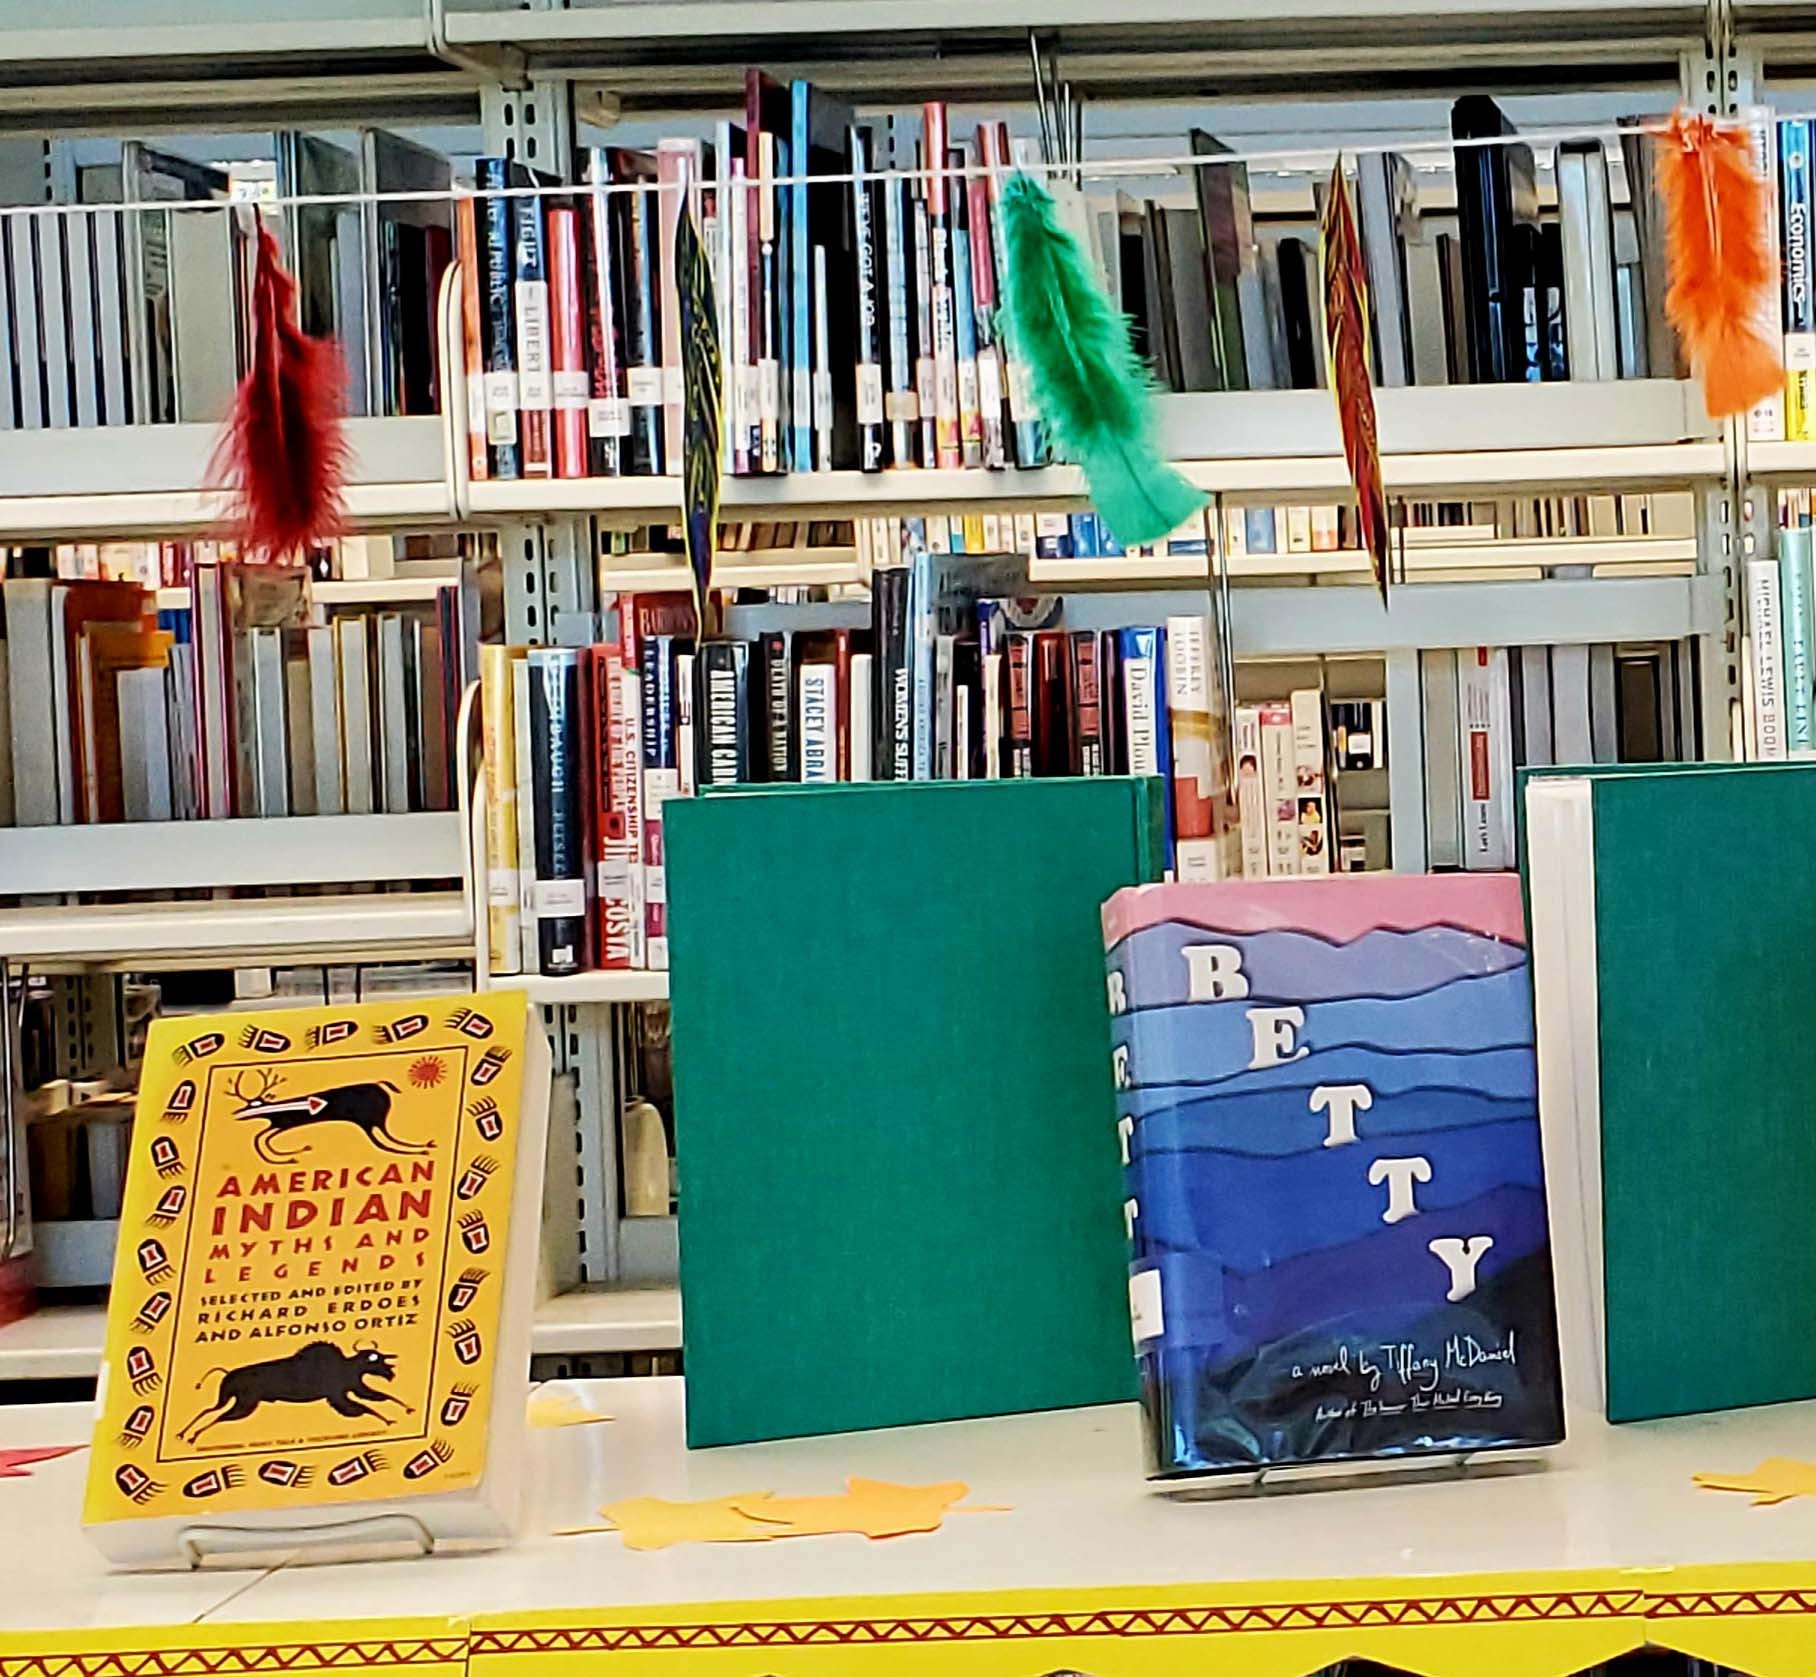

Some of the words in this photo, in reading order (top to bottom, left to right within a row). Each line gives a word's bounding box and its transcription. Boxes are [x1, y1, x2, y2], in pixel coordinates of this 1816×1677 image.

[1788, 203, 1807, 303] Economics
[522, 305, 543, 374] LIBERT
[1129, 666, 1149, 721] David
[1759, 655, 1776, 707] LEWIS
[709, 669, 737, 744] AMERICAN
[804, 678, 825, 733] STACEY
[771, 730, 788, 772] NATION
[1131, 729, 1151, 771] Plou
[1762, 713, 1777, 757] BOOM
[711, 749, 738, 784] CARN
[804, 738, 826, 779] ABRA
[894, 742, 910, 781] SUFF
[624, 751, 638, 838] CITIZENSHIP
[1106, 968, 1140, 1240] BETT
[216, 1159, 437, 1199] AMERICAN
[210, 1188, 432, 1237] INDIAN
[206, 1234, 335, 1261] MYTHS
[355, 1227, 432, 1249] AND
[203, 1251, 427, 1285] LEGENDS
[196, 1303, 310, 1326] RICHARD
[326, 1294, 422, 1316] ERDOES
[199, 1288, 282, 1307] SELECTED
[288, 1285, 328, 1301] AND
[332, 1280, 395, 1297] EDITED
[400, 1278, 425, 1292] BY
[193, 1326, 242, 1344] AND
[247, 1317, 348, 1342] ALFONSO
[353, 1312, 420, 1334] ORTIZ
[1291, 1365, 1304, 1379] a
[1310, 1345, 1351, 1378] novel
[1358, 1349, 1383, 1393] by
[1379, 1343, 1440, 1392] Tiffany
[1444, 1328, 1517, 1370] McDaniel
